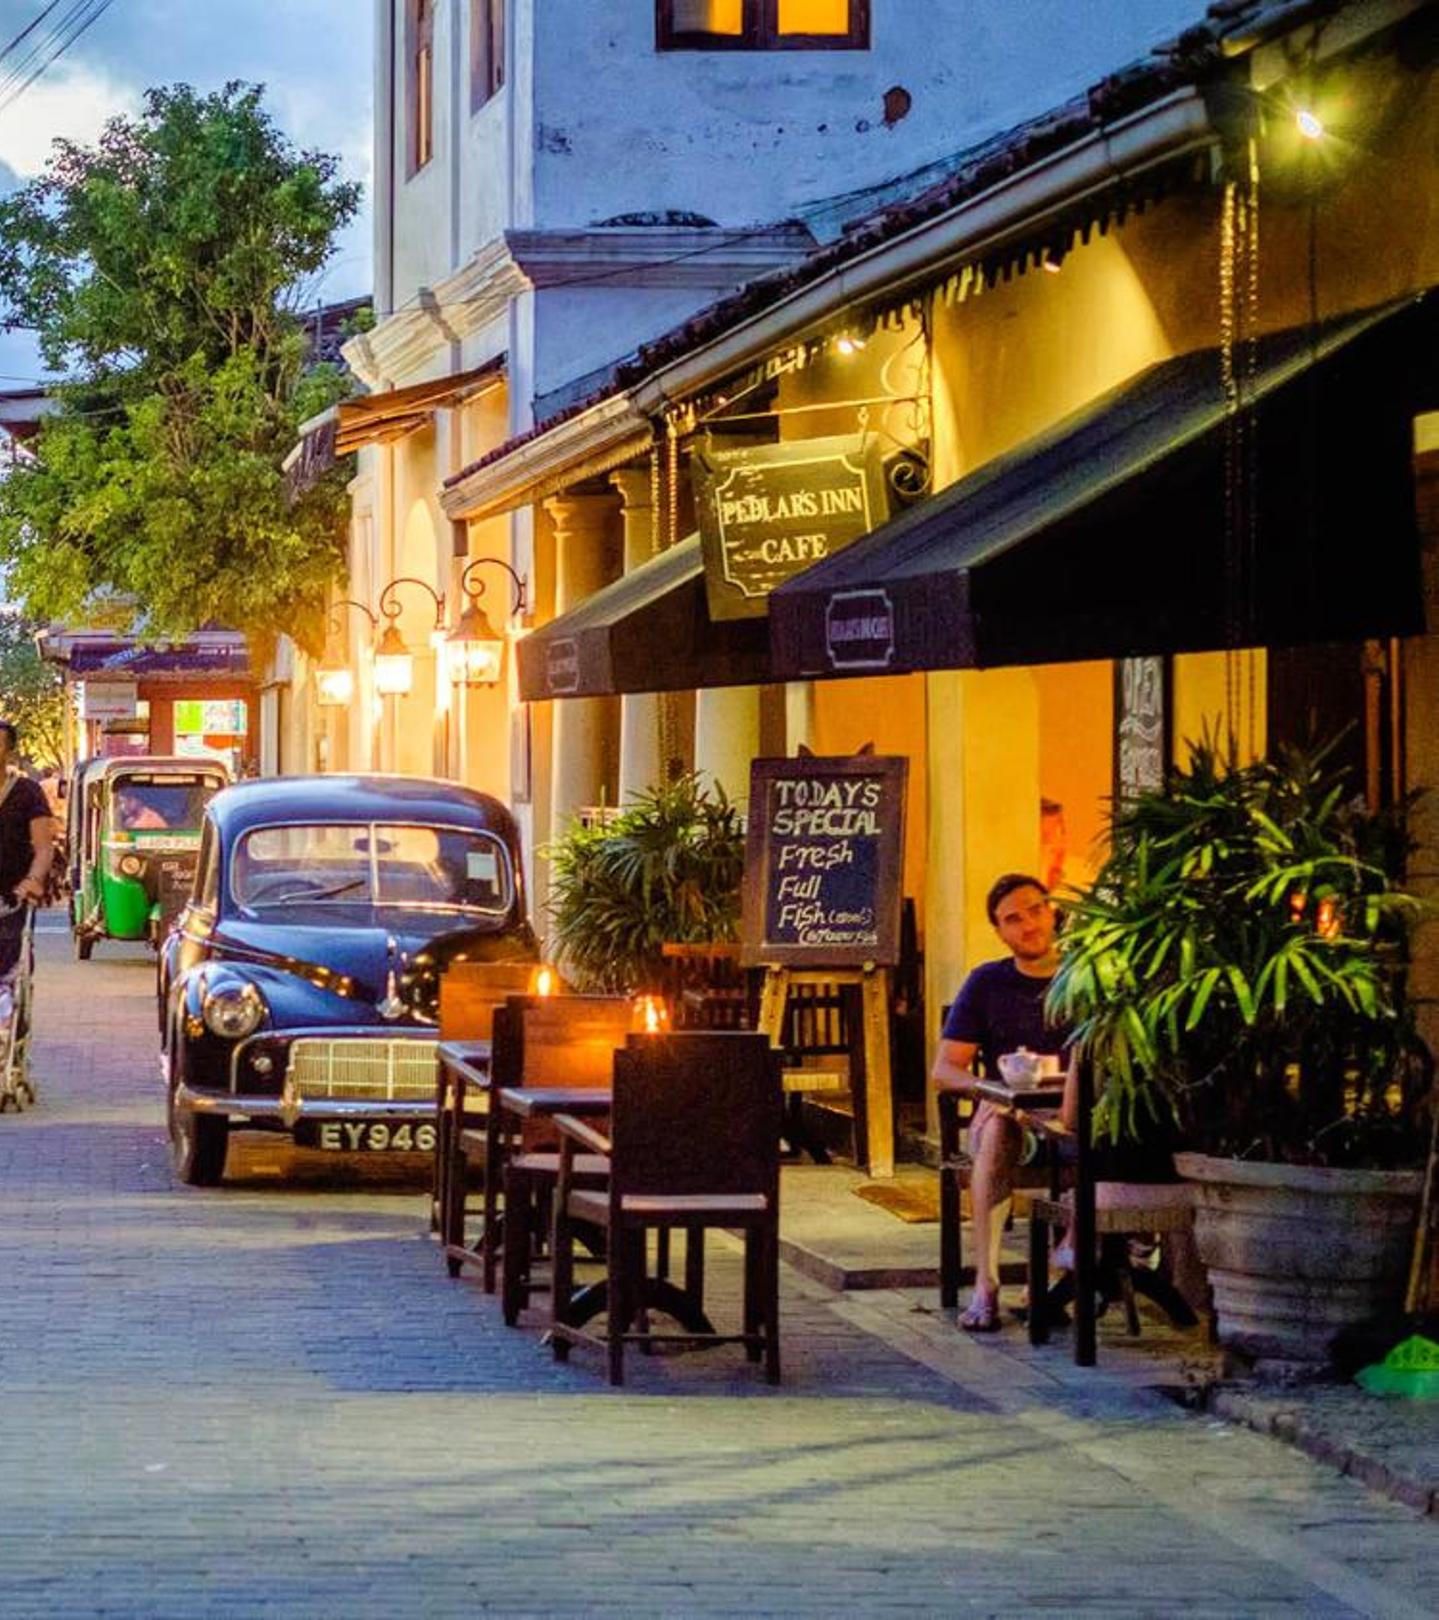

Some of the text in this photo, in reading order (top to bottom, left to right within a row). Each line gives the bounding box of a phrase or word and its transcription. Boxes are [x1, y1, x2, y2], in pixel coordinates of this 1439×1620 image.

[820, 487, 863, 515] INN
[761, 533, 828, 564] CAFE
[772, 808, 882, 837] SPECIAL
[778, 839, 854, 870] Fresh
[777, 874, 822, 901] Full
